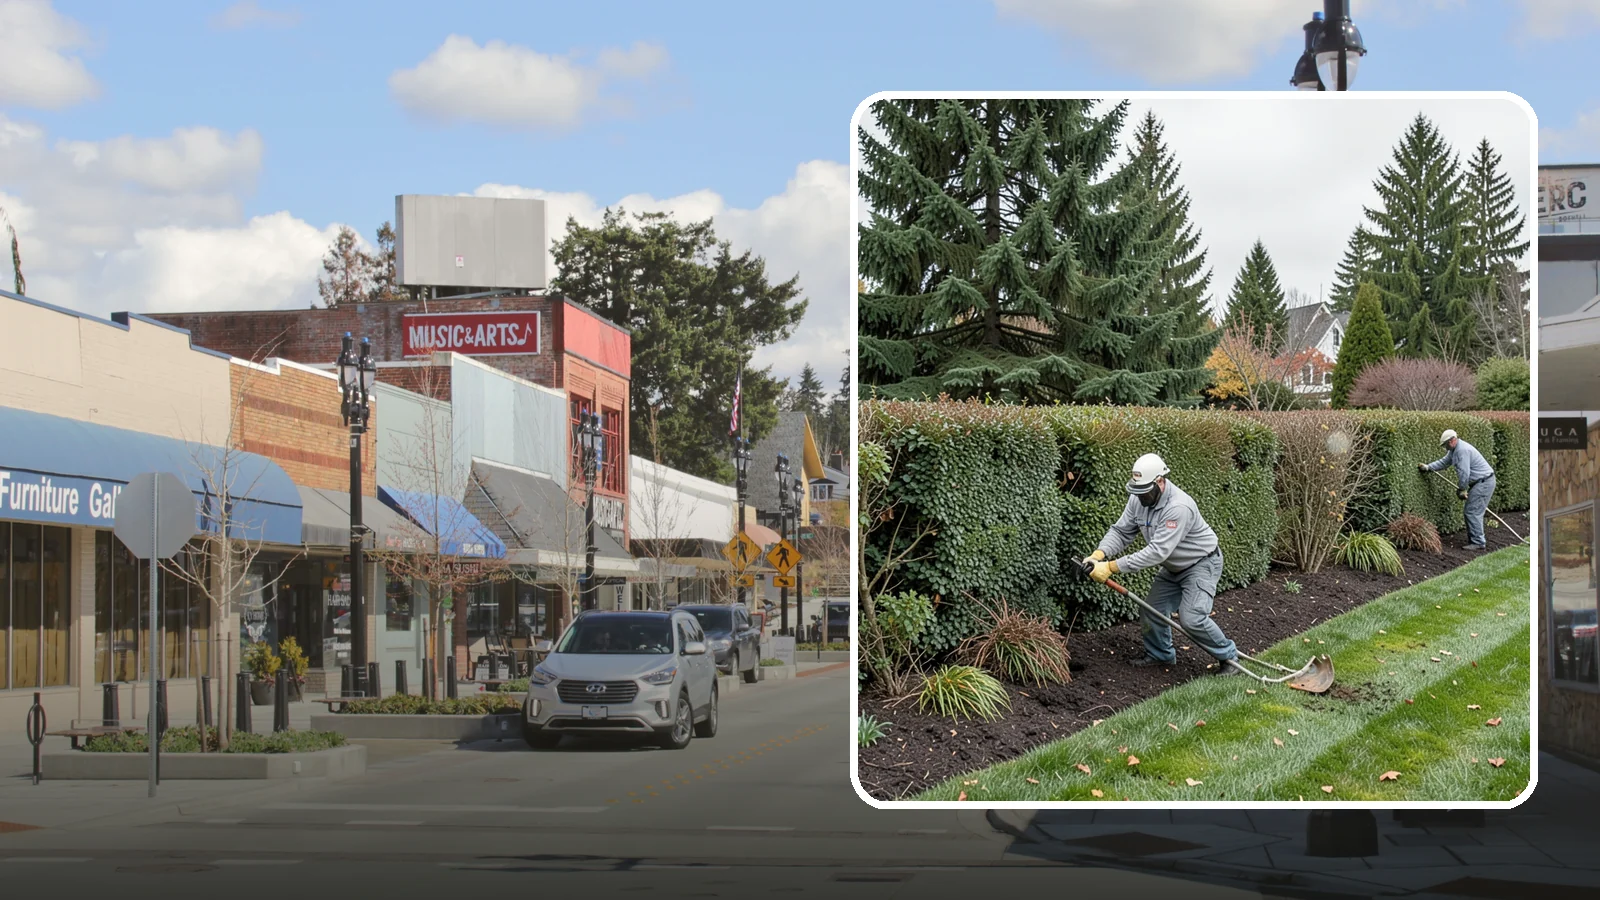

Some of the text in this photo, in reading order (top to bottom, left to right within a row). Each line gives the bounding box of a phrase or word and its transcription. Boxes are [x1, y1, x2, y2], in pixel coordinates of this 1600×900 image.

[409, 323, 520, 349] MUSIC&ARTS
[0, 471, 122, 519] Furniture Gal
